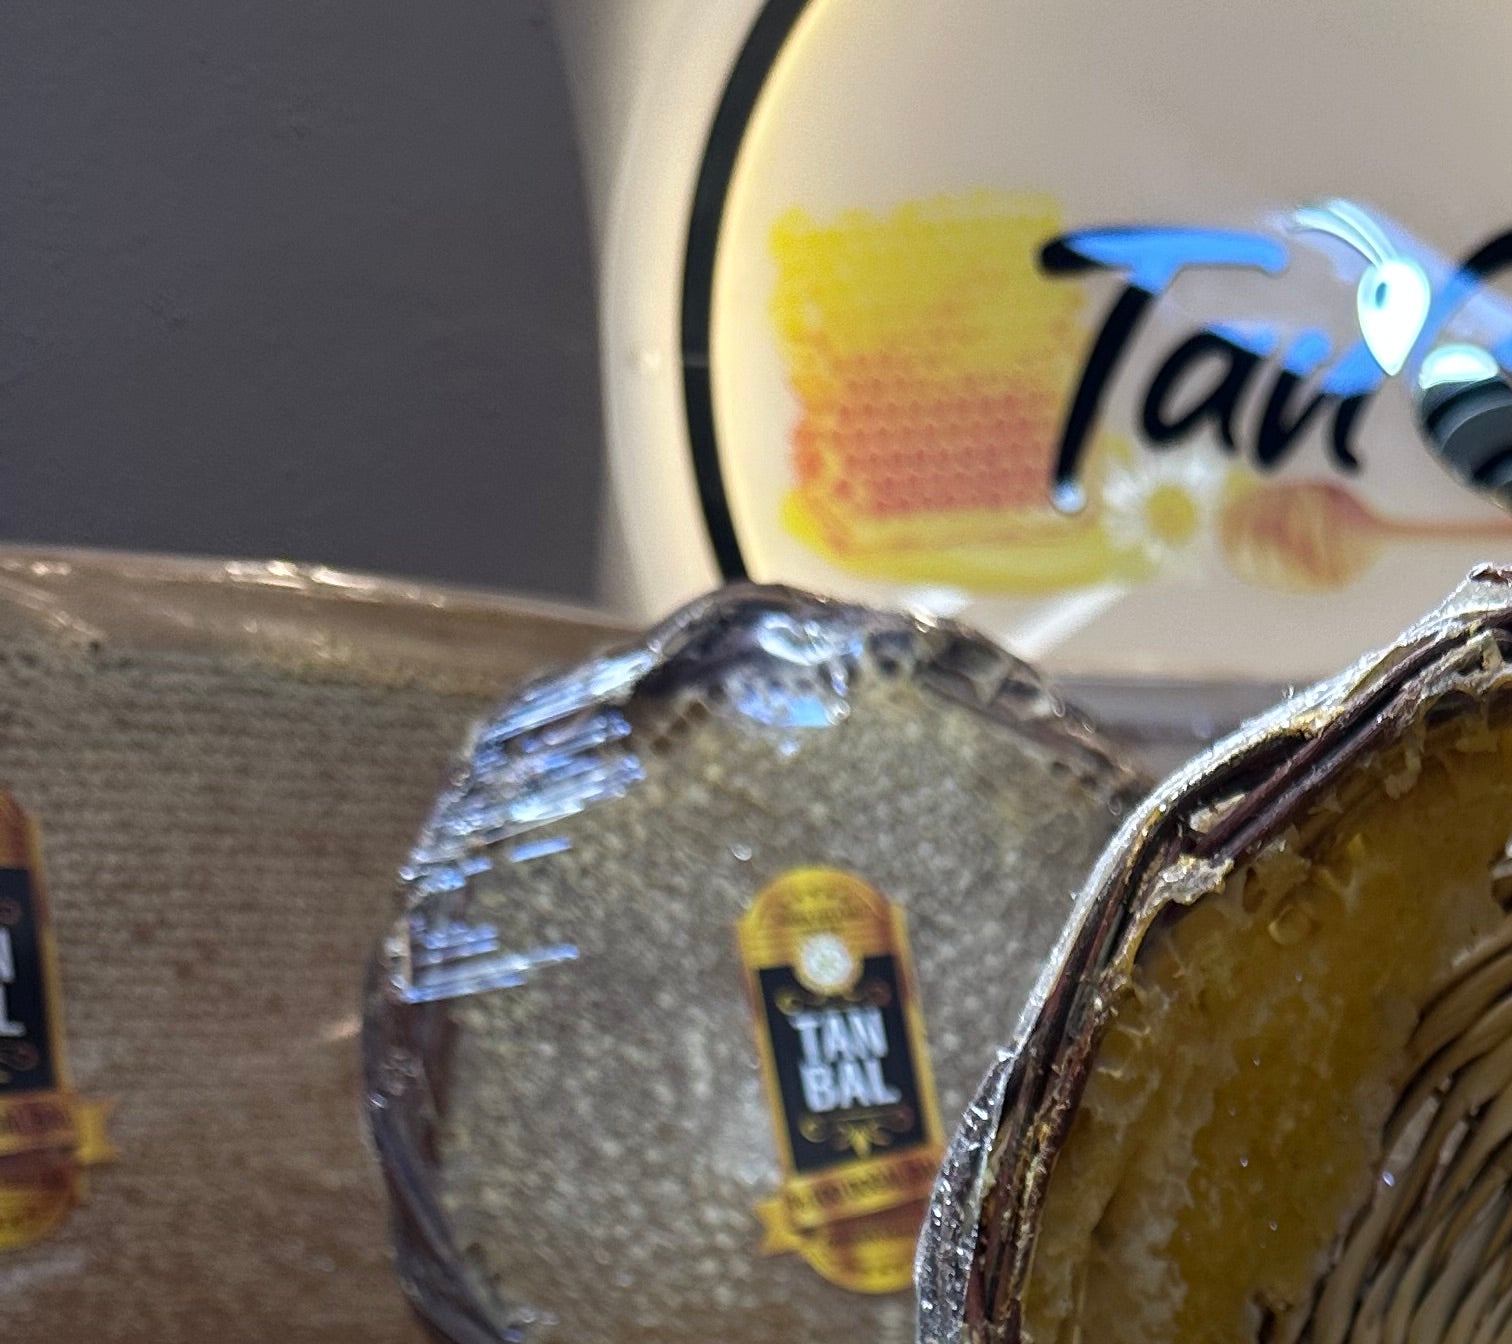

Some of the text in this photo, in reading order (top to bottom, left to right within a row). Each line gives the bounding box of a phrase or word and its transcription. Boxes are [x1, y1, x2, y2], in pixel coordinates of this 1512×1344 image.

[1037, 224, 1363, 514] Tan
[790, 1005, 889, 1065] TAN
[800, 1059, 903, 1114] BAL
